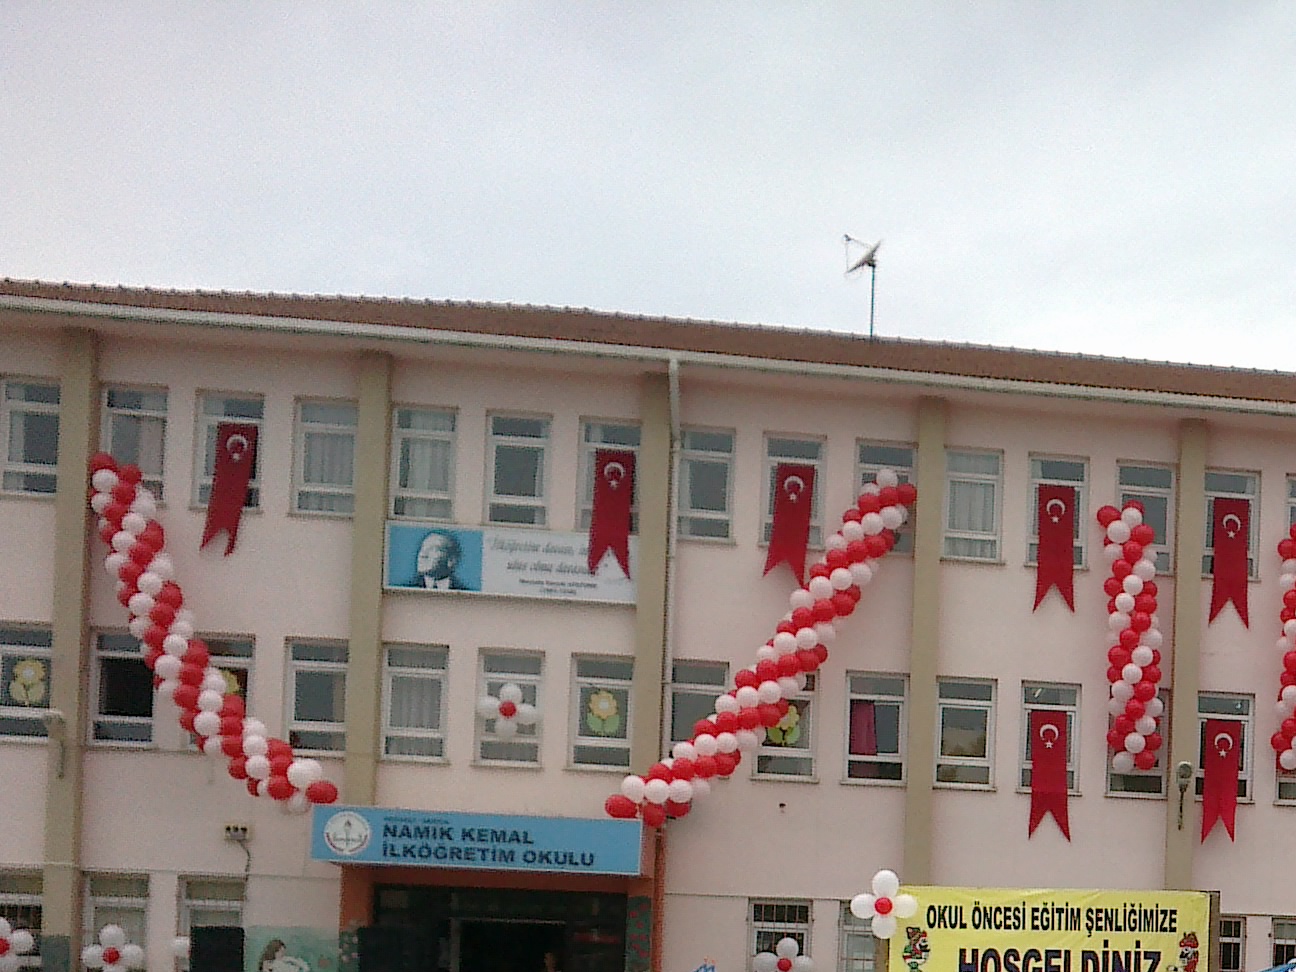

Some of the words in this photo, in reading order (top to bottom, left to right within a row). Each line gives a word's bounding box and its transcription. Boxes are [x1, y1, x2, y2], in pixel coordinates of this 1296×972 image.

[383, 823, 453, 841] NAMIK
[461, 829, 534, 844] KEMAL
[383, 842, 515, 863] İLKÖĞRETİM
[523, 850, 594, 866] OKULU
[926, 905, 968, 929] OKUL
[972, 901, 1027, 930] ÖNCESİ
[1031, 902, 1081, 931] EĞİTİM
[1085, 903, 1177, 937] ŞENLİĞİMİZE
